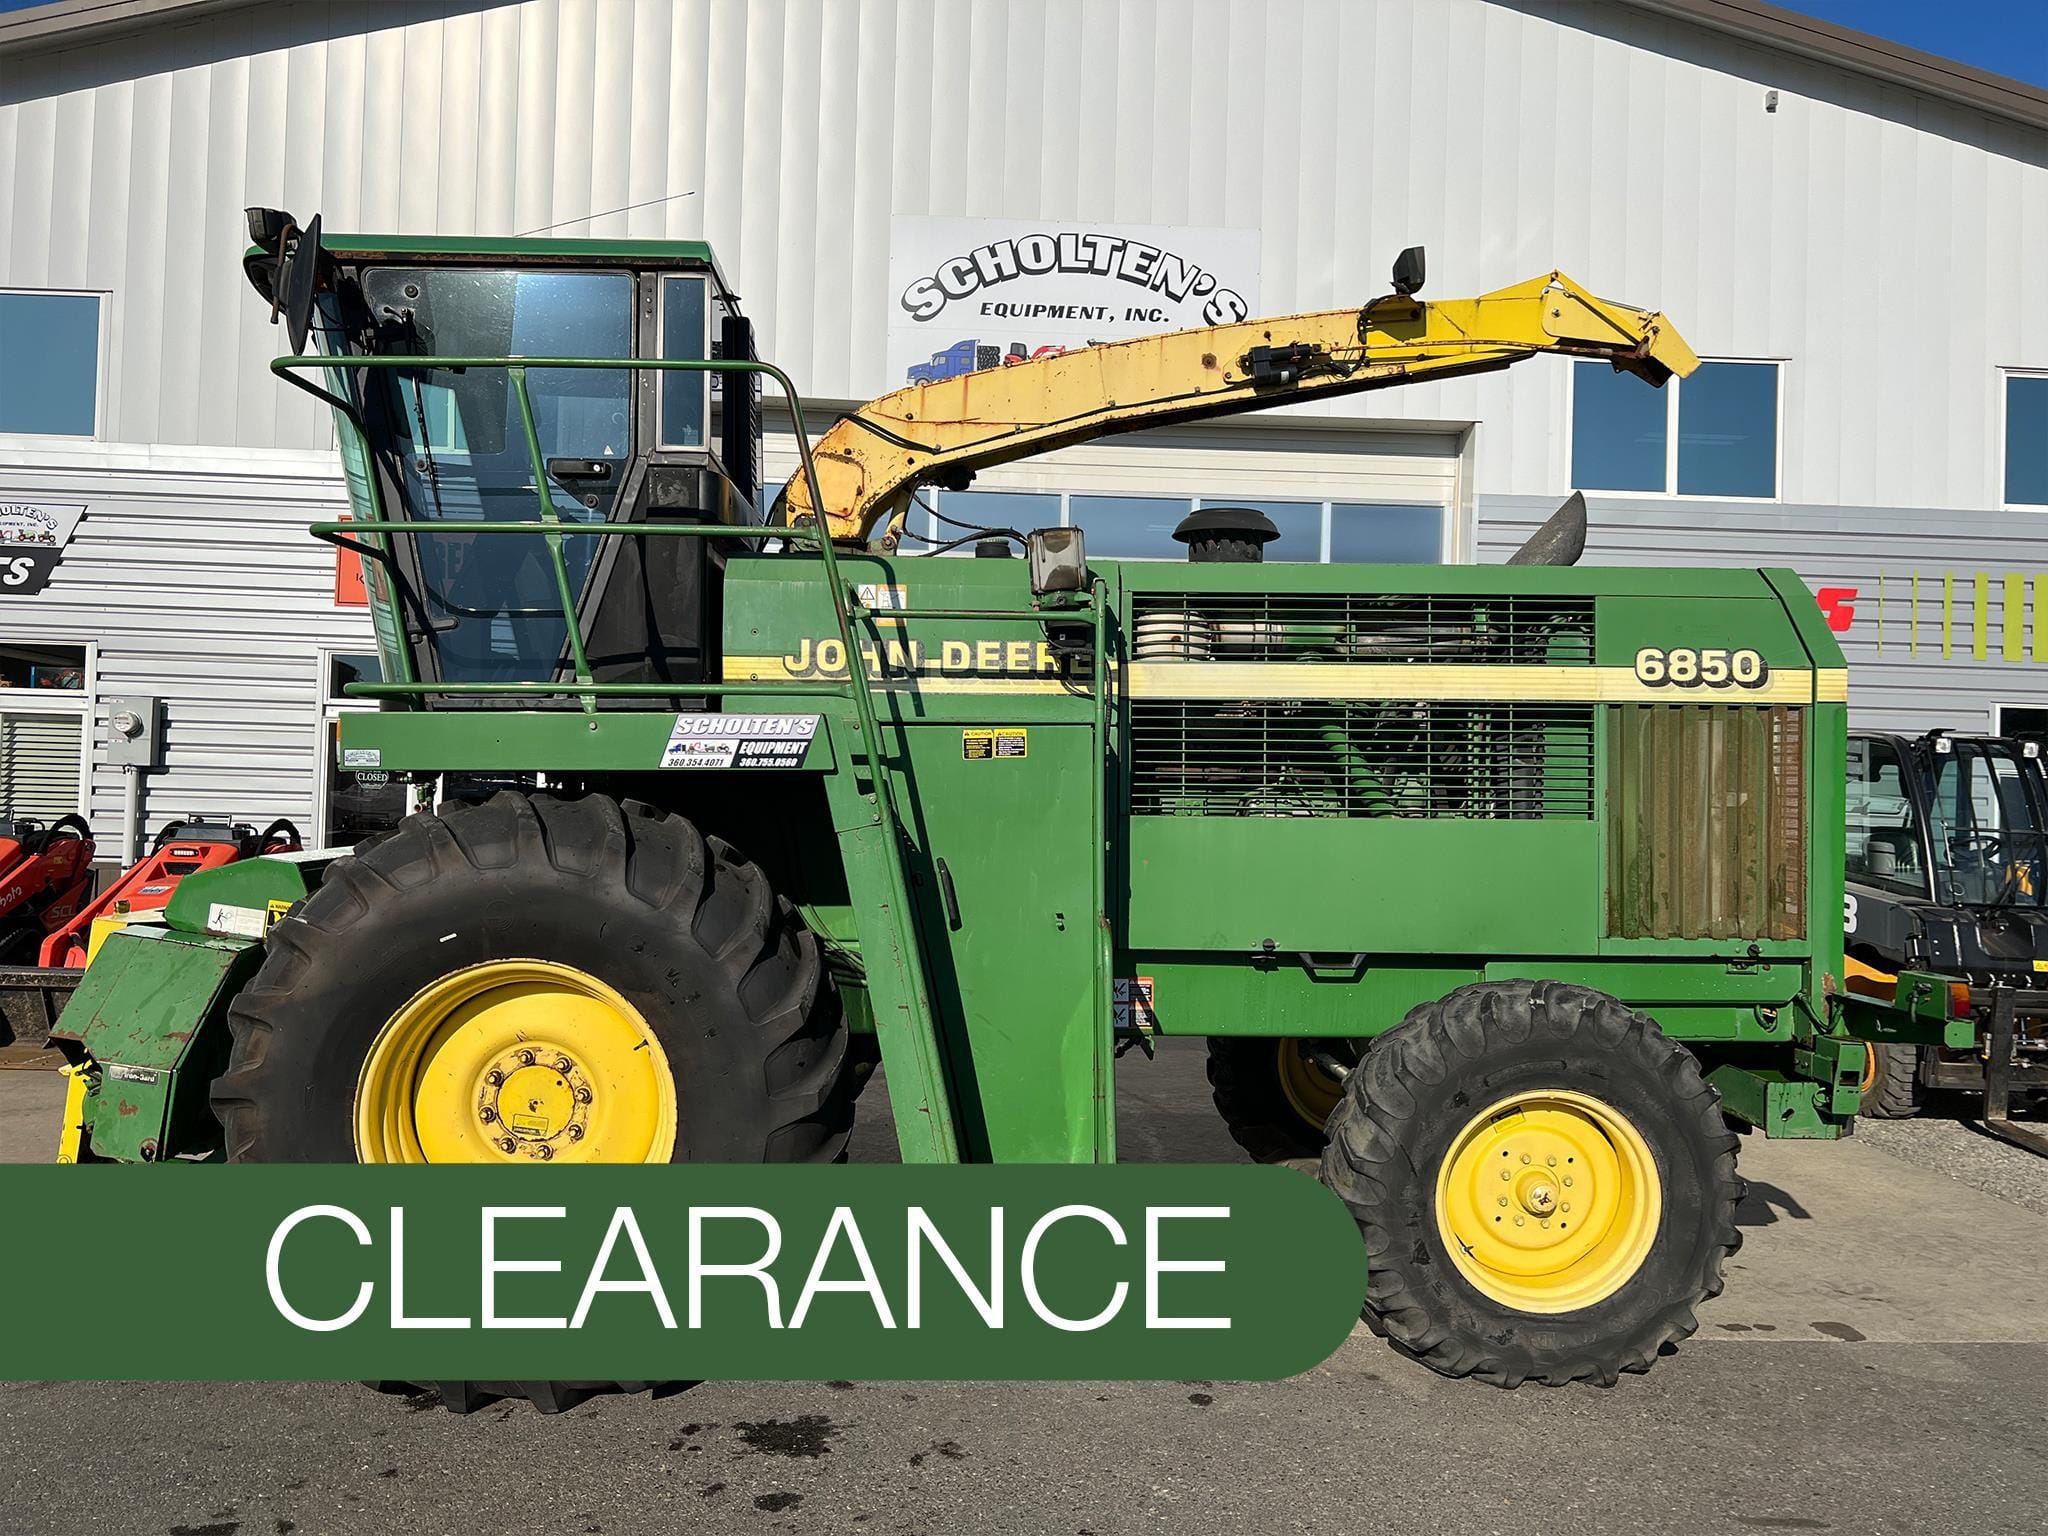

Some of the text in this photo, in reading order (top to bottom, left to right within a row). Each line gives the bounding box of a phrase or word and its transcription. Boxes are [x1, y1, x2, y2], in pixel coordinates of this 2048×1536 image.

[901, 233, 1248, 326] SCHOLTEN'S
[979, 302, 1170, 323] EQUIPMENT, INC.
[0, 504, 58, 530] OLTEN'S
[0, 556, 35, 586] S
[783, 637, 1095, 681] JOHN DEERE
[1634, 647, 1769, 689] 6850
[675, 717, 814, 736] SCHOLTEN'S
[739, 741, 808, 755] EQUIPMENT
[668, 758, 725, 767] 360.354.4071
[739, 757, 799, 768] 360.755.0560
[357, 772, 388, 782] CLOSED
